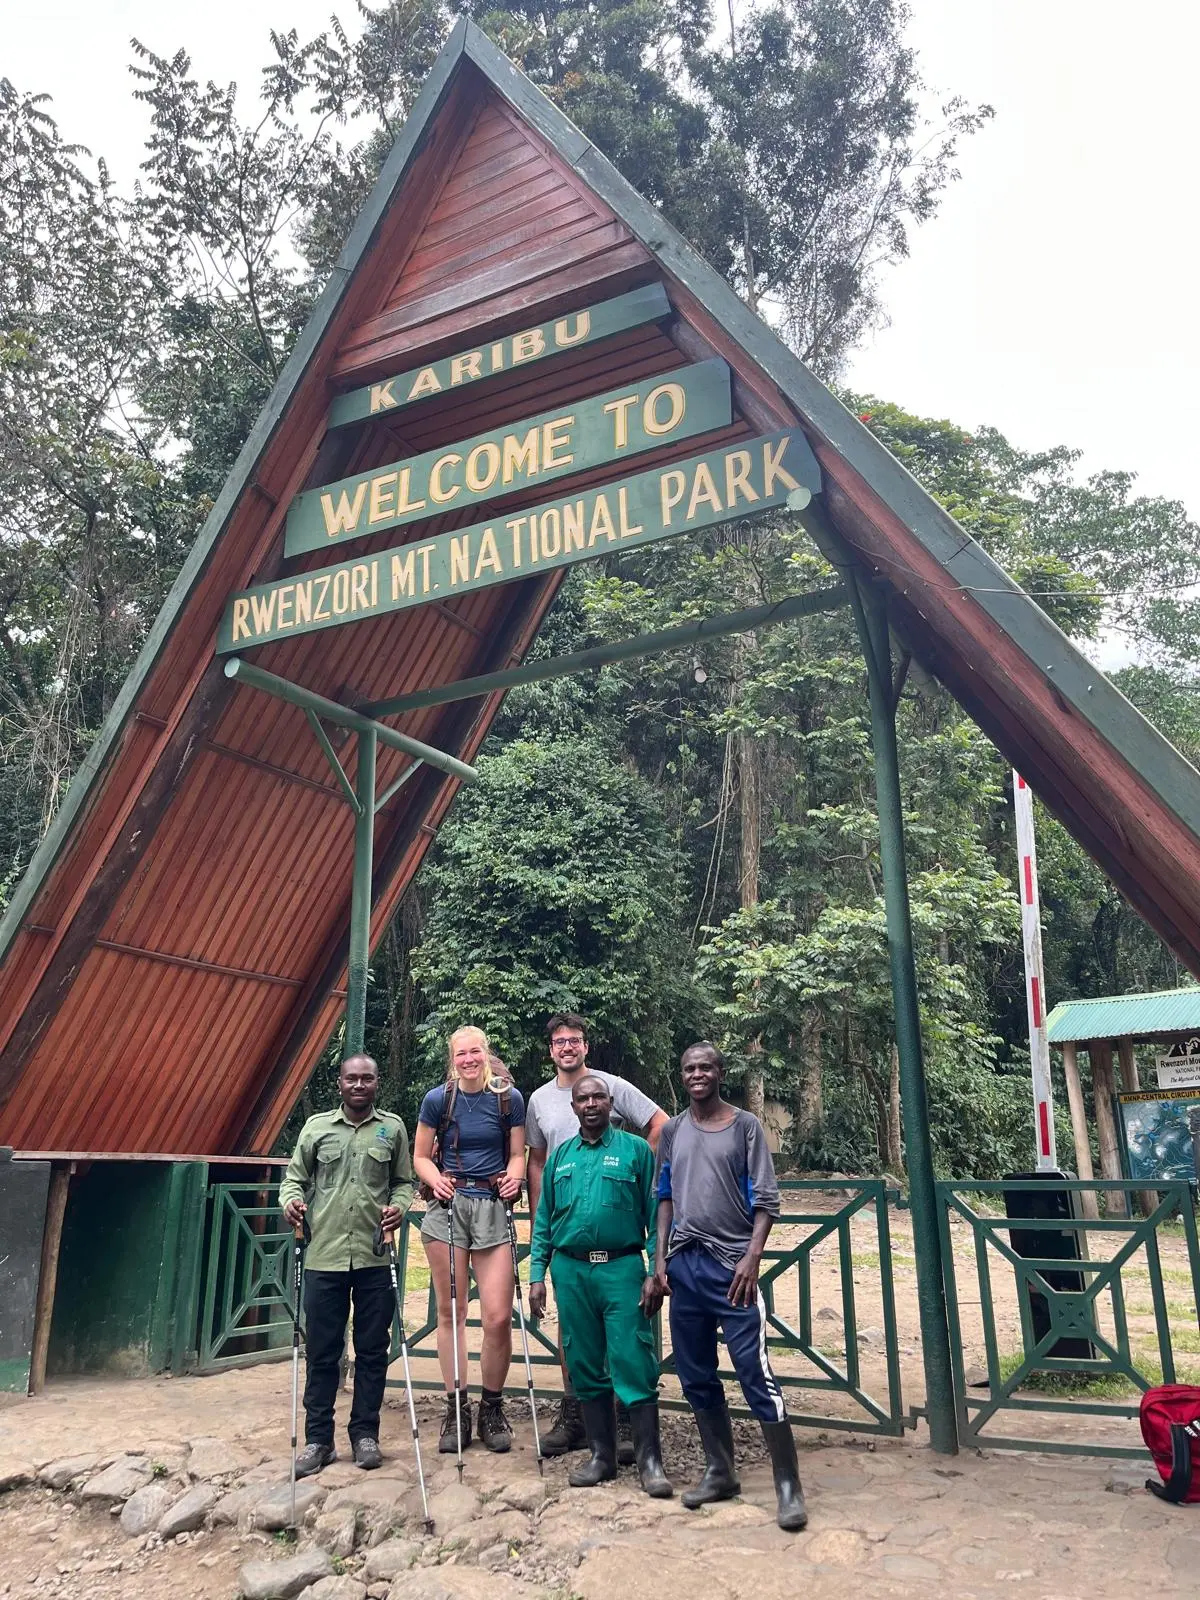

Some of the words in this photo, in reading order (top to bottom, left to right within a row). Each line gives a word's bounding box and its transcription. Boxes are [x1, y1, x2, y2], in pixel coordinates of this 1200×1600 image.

[369, 310, 591, 414] KARIBU
[320, 415, 575, 537] WELCOME
[603, 382, 686, 449] TO
[231, 560, 379, 643] RWENZORI
[391, 543, 441, 601] MT.
[449, 486, 644, 587] NATIONAL
[659, 435, 799, 527] PARK
[1160, 1058, 1188, 1068] Rwenzori
